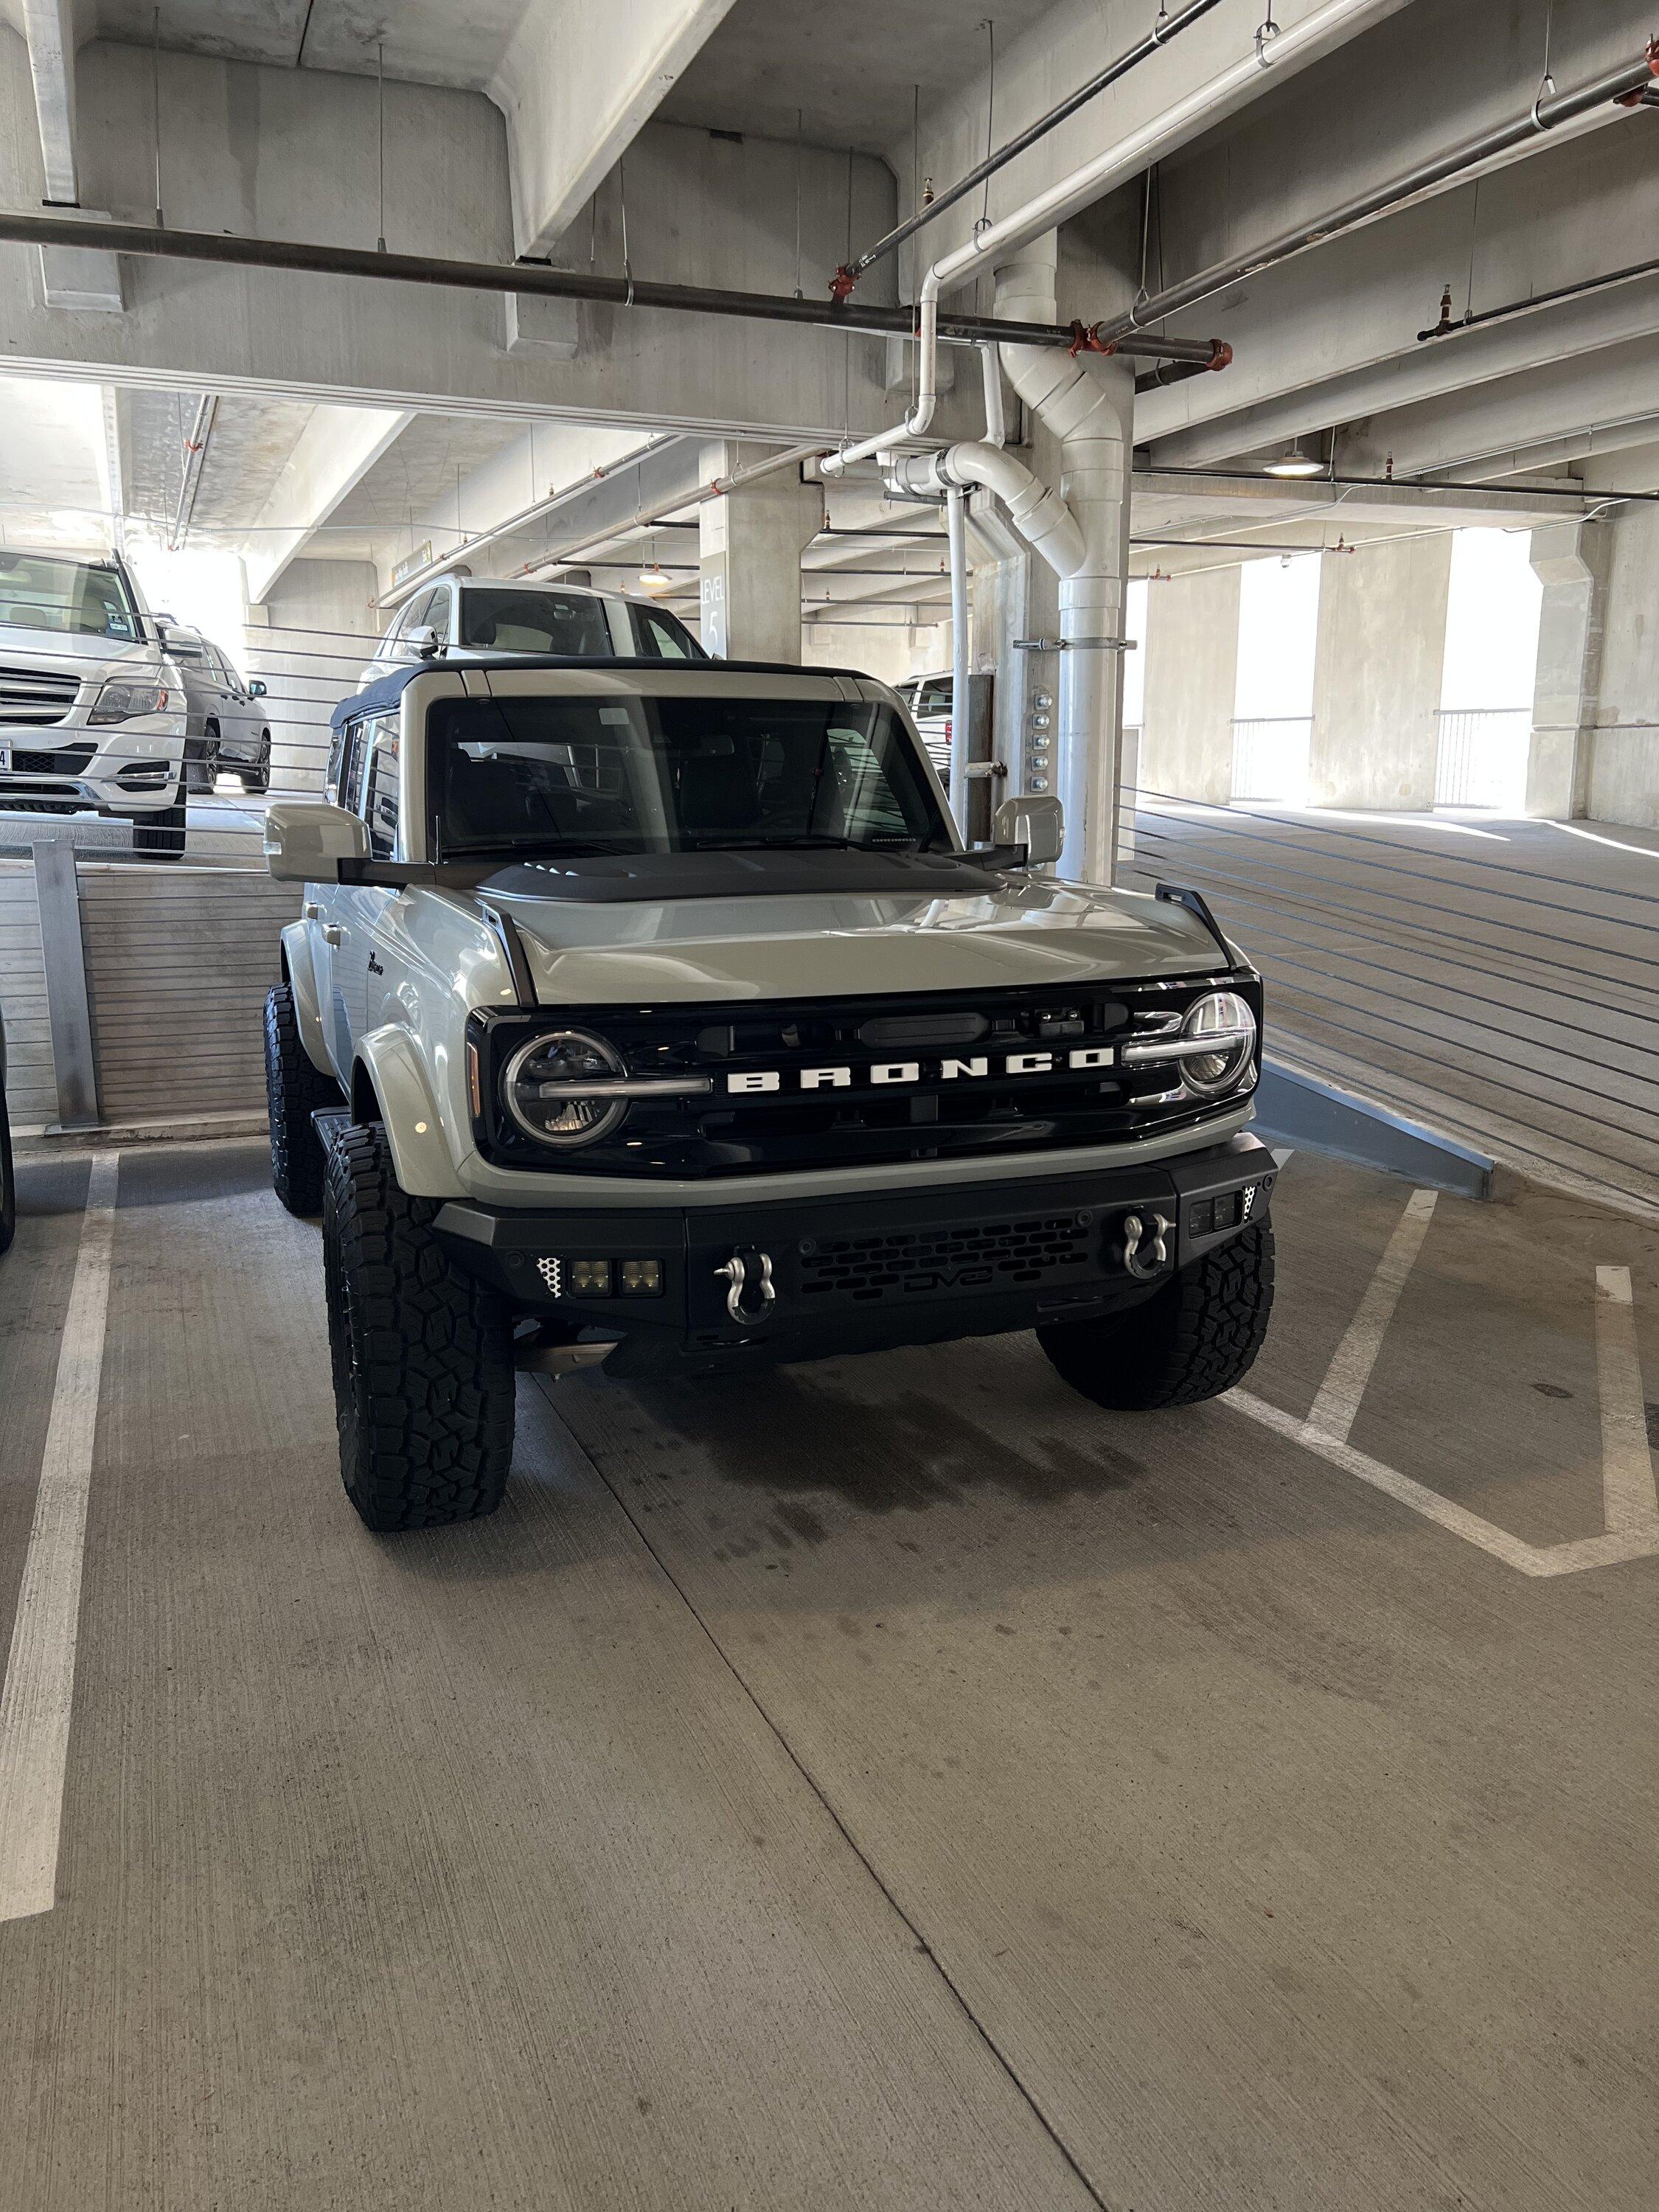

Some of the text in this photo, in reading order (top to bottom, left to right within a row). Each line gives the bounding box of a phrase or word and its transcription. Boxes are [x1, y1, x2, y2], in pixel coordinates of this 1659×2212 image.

[701, 575, 725, 605] LEVEL
[709, 611, 719, 647] 5
[726, 1046, 1115, 1093] BRONCO
